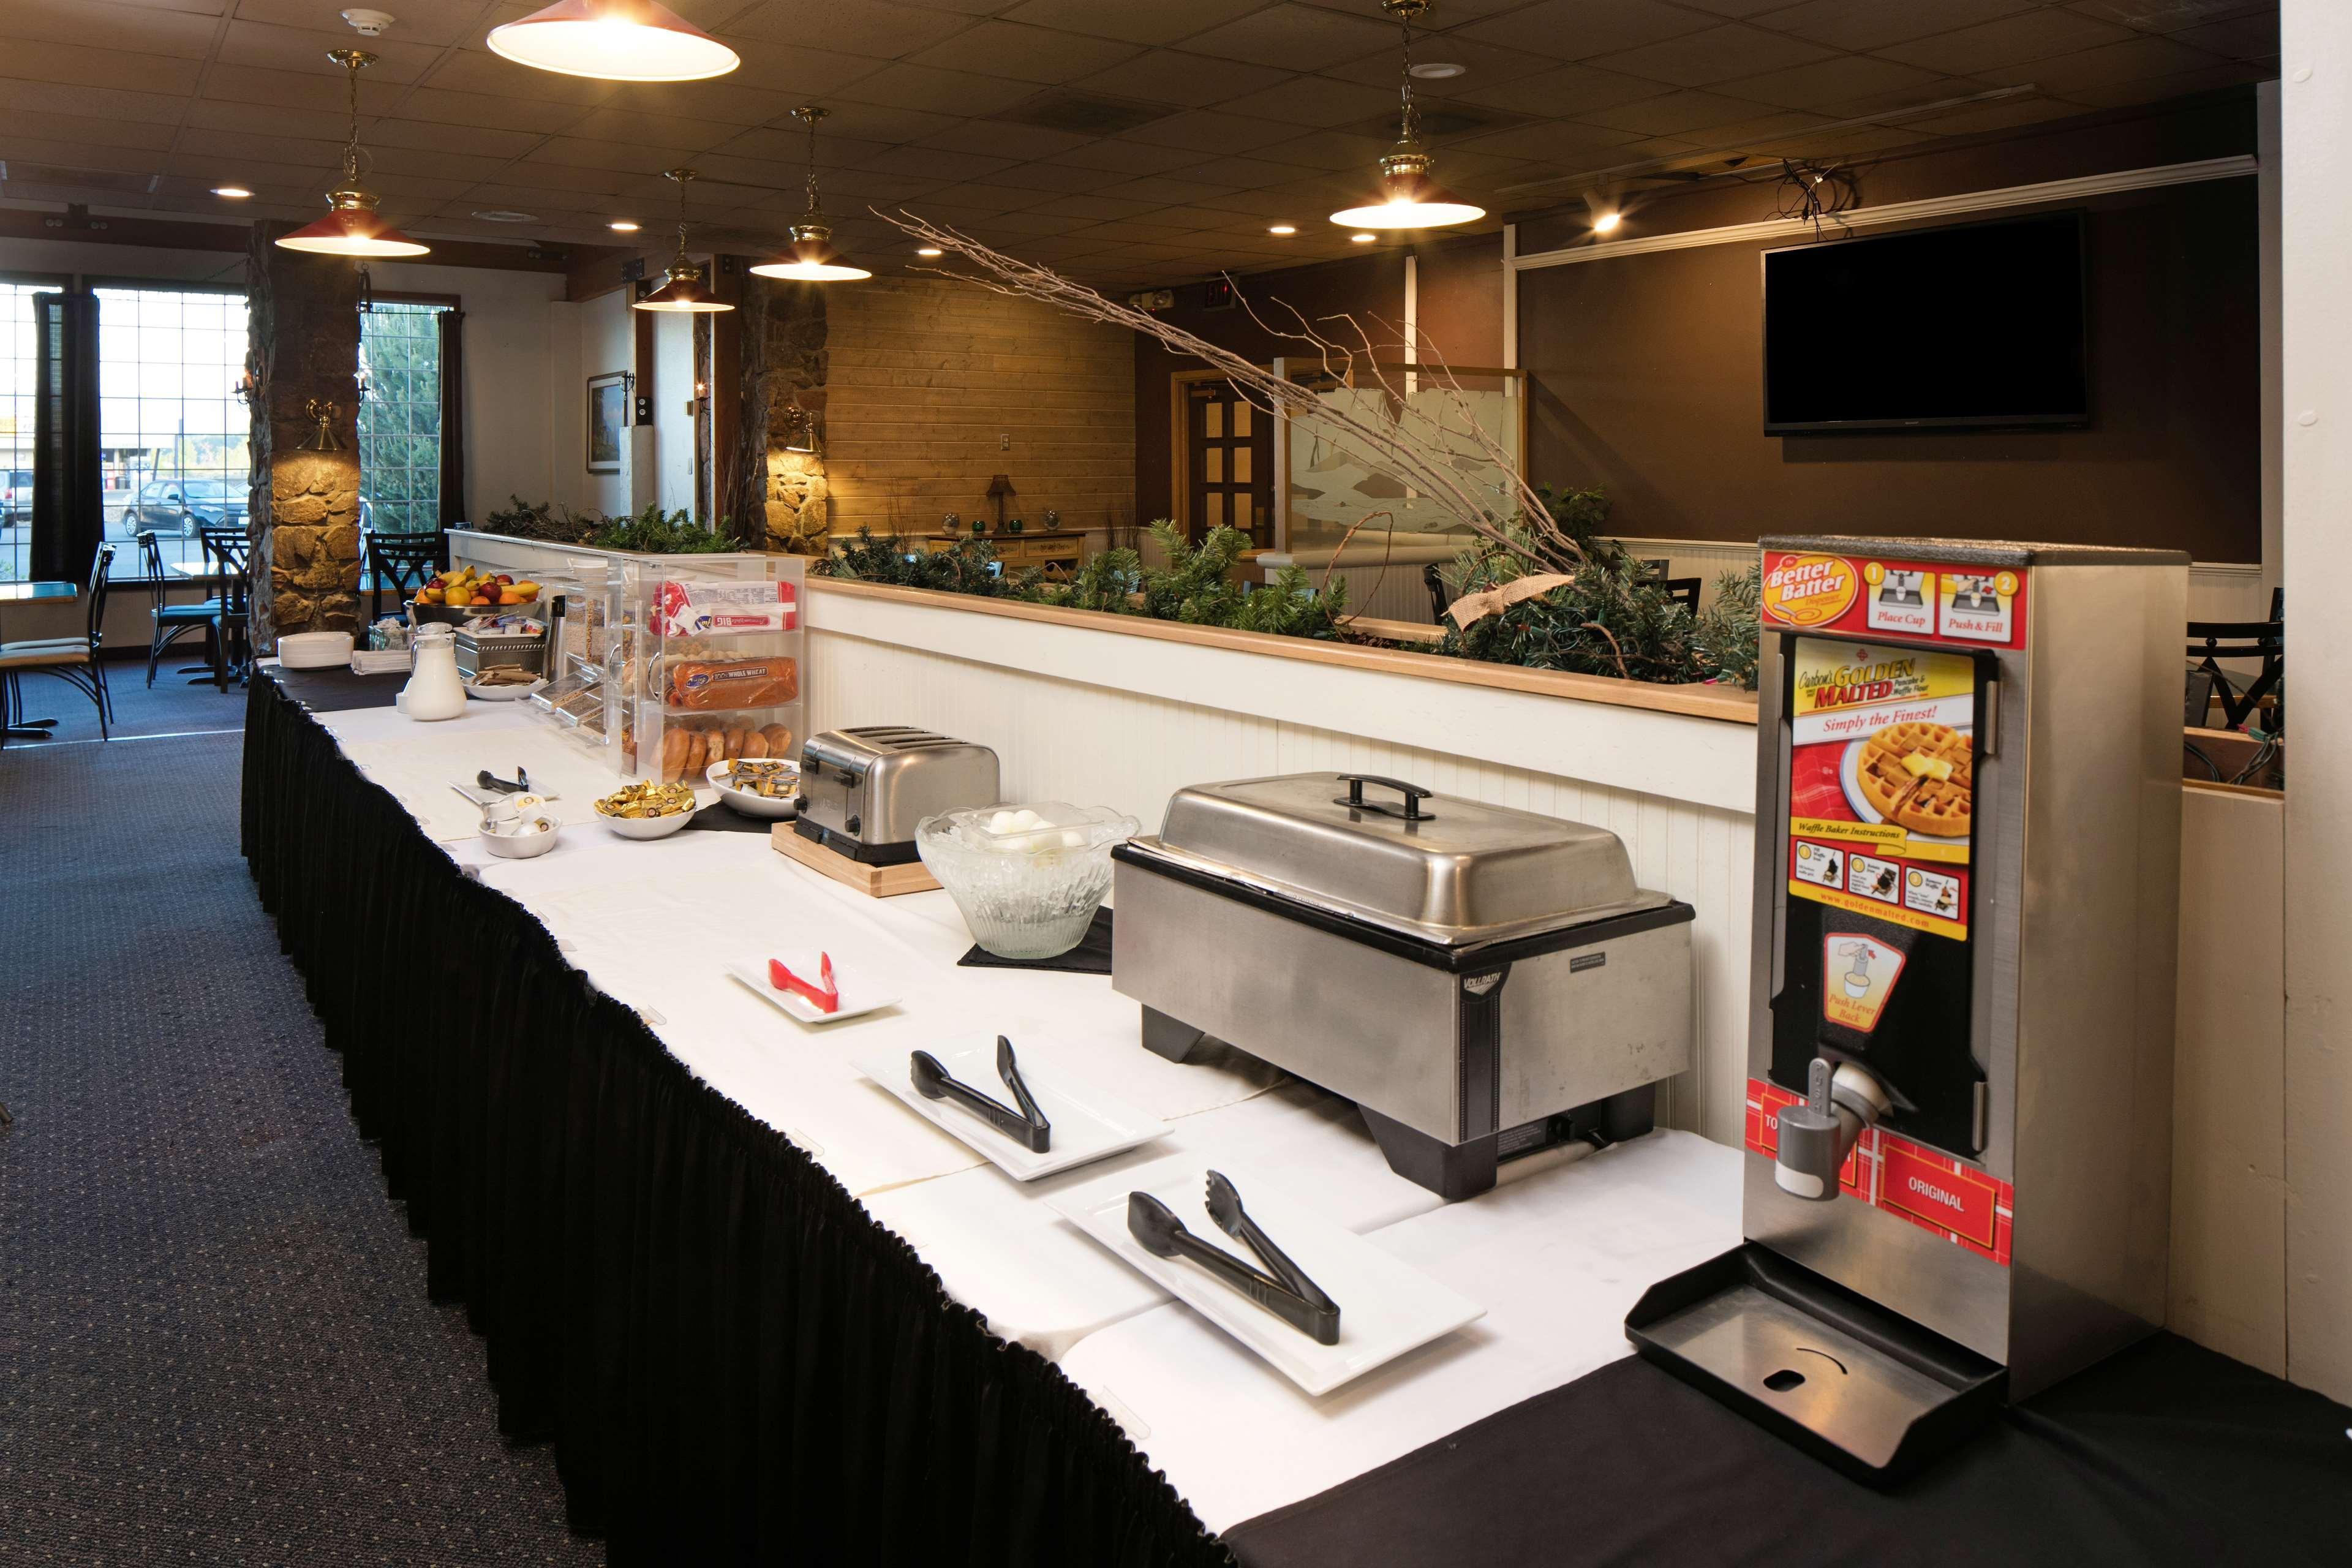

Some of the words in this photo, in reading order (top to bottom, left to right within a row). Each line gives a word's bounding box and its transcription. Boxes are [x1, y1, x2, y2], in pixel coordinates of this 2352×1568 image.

[1770, 560, 1835, 588] Better
[1871, 567, 1877, 579] 1
[2000, 576, 2011, 590] 2
[1781, 575, 1845, 601] Batter
[1877, 611, 1902, 624] Place
[1905, 614, 1926, 628] Cup
[1948, 618, 1973, 631] Push
[1975, 622, 1983, 631] &
[1985, 620, 2003, 633] Fill
[1799, 669, 1834, 689] Carbon's
[1834, 658, 1915, 688] GOLDEN
[1814, 680, 1893, 708] MALTED
[1823, 715, 1865, 733] Simply
[1869, 712, 1890, 725] the
[1893, 705, 1938, 723] Finest!
[1799, 823, 1823, 833] Waffle
[1826, 824, 1848, 834] Baker
[1850, 827, 1901, 839] Instructions
[1821, 892, 1929, 927] www.goldenmalted.com
[1464, 972, 1501, 989] VOLLRATH
[1829, 993, 1851, 1008] Push
[1852, 1000, 1876, 1015] Lever
[1839, 1009, 1861, 1022] Back
[1909, 1176, 1964, 1212] ORIGINAL
